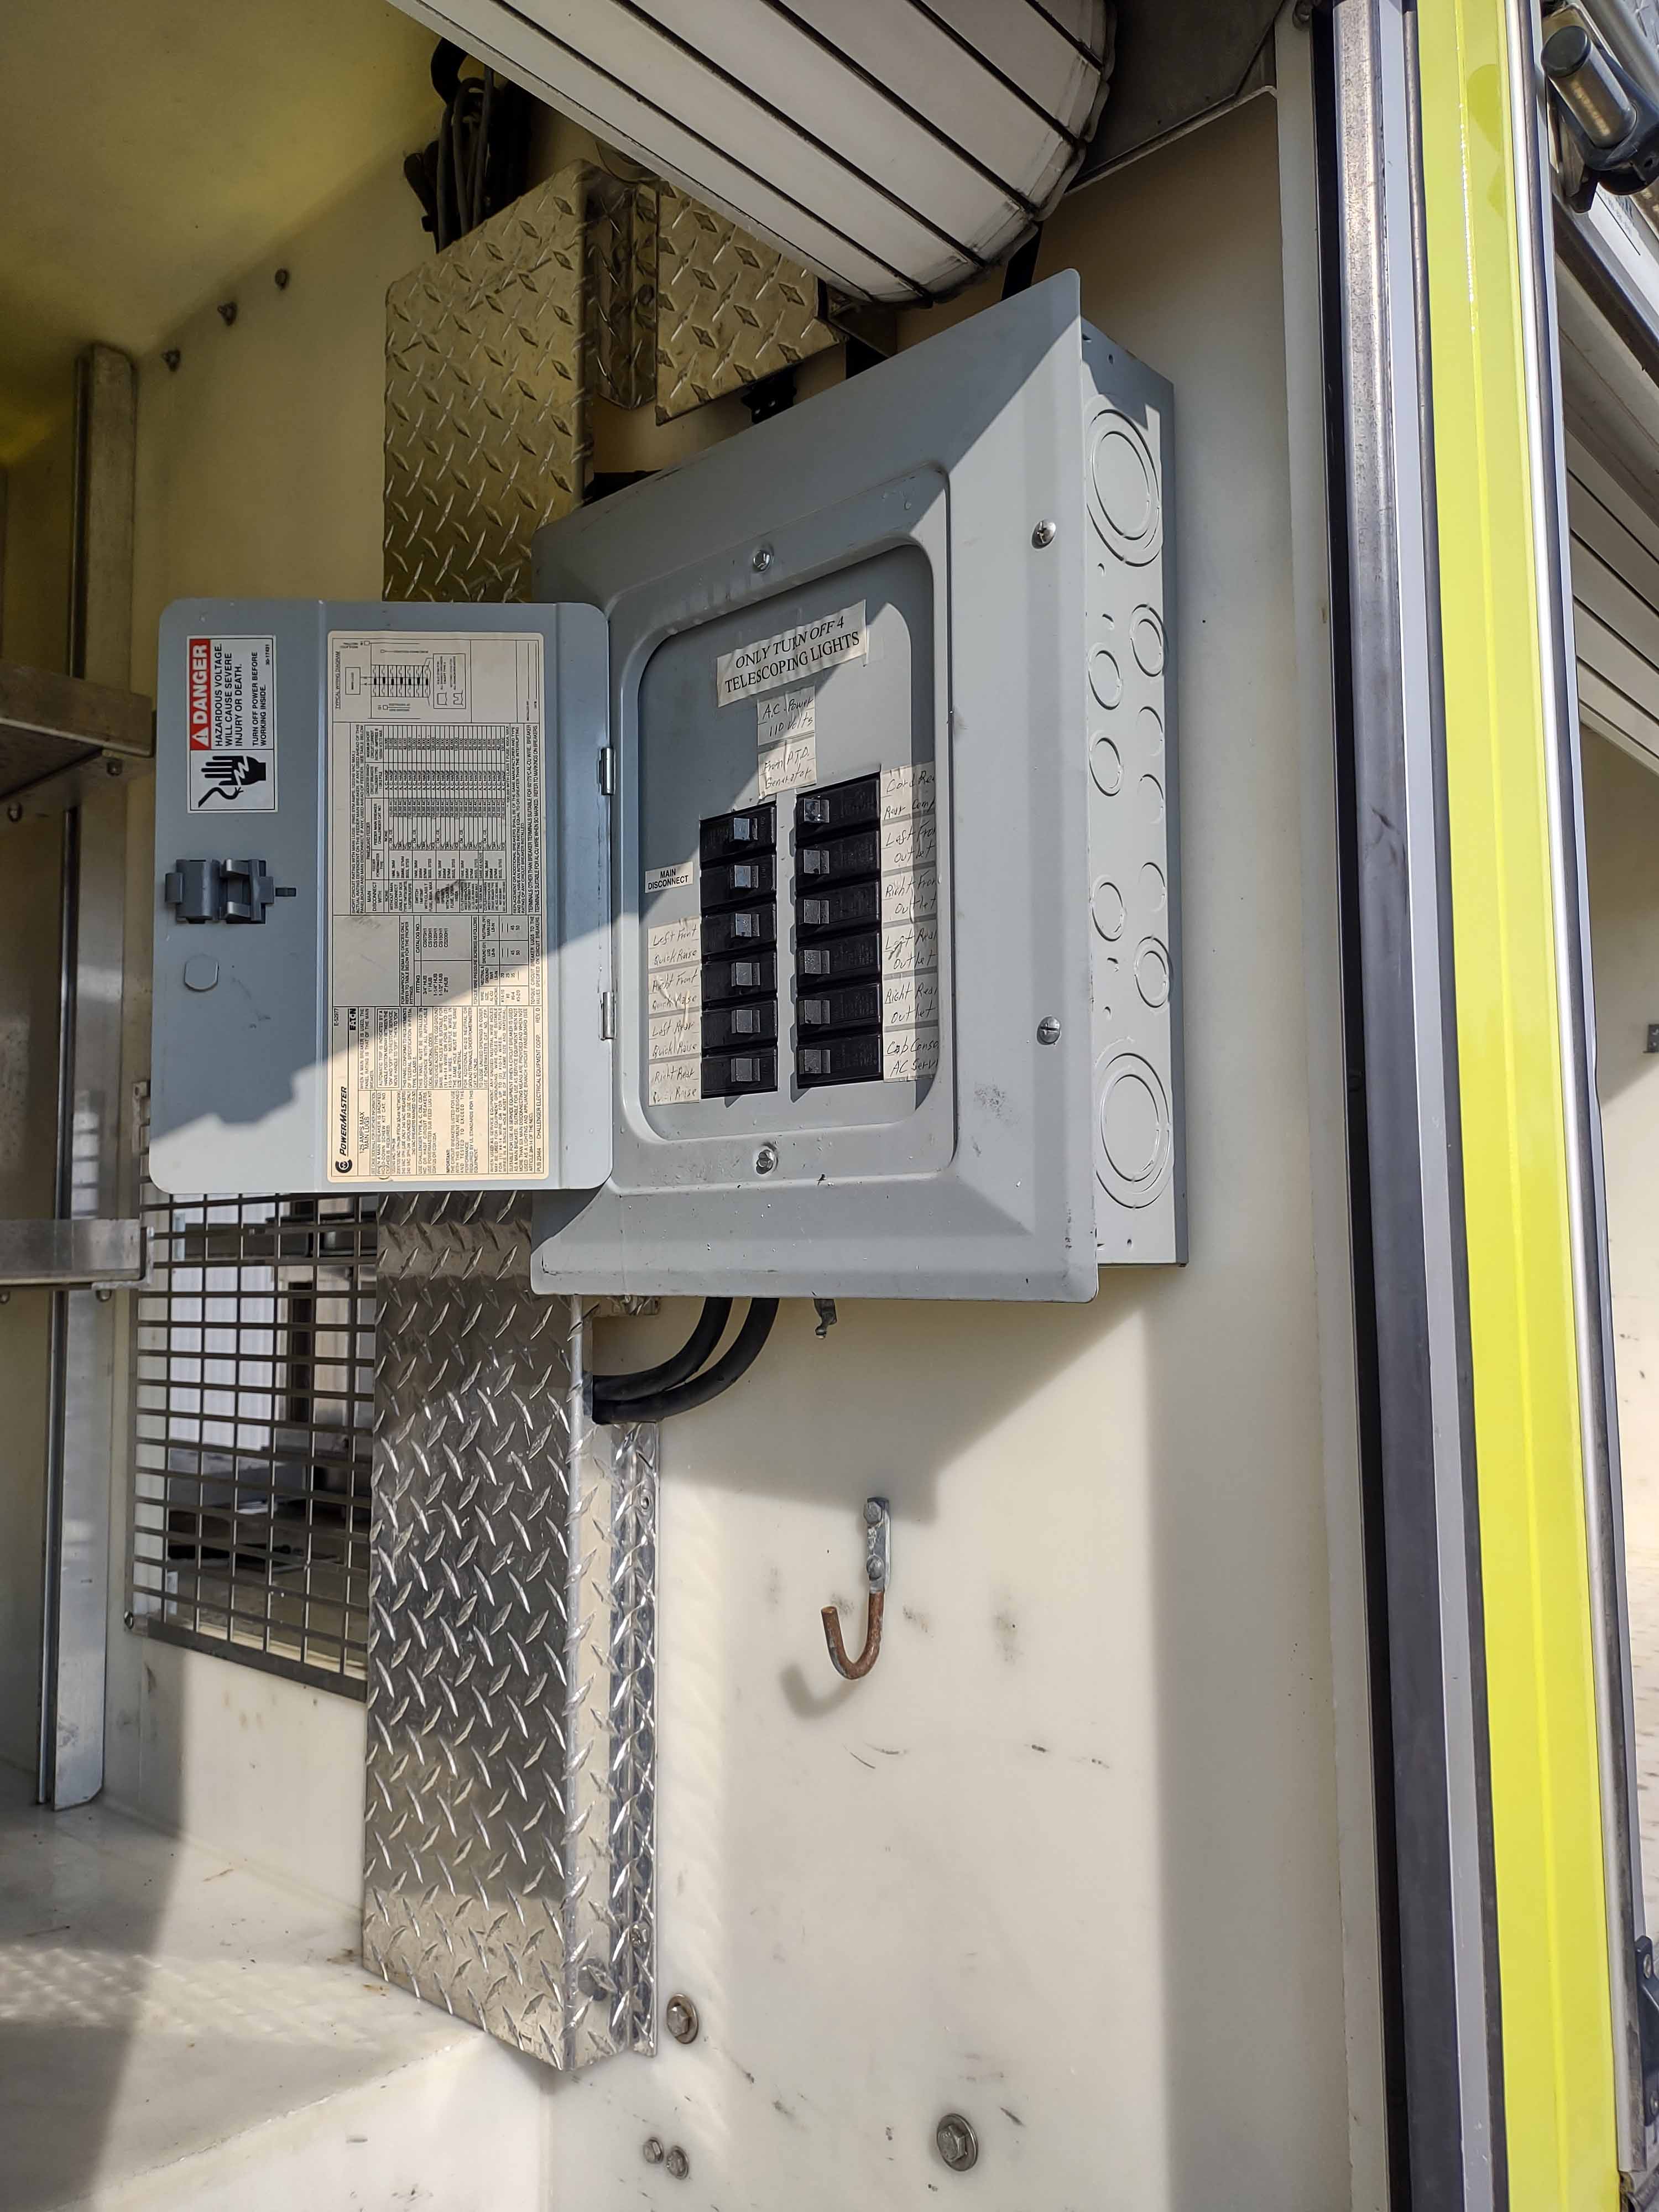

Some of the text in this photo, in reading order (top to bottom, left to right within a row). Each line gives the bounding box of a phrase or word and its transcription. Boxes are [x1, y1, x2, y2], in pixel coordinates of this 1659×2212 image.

[736, 616, 844, 668] ONLY TURN OFF 4
[725, 632, 859, 693] TELESCOPING LIGHTS
[192, 644, 207, 724] DANGER
[234, 699, 242, 712] OR
[787, 698, 814, 712] Power
[215, 690, 223, 747] HAZARDOUS
[769, 712, 813, 737] 110 Volts
[764, 760, 783, 772] From
[765, 764, 812, 789] Generator
[886, 774, 915, 792] Cord
[894, 839, 935, 863] Outlet
[648, 875, 688, 890] DISCONNECT
[660, 868, 676, 879] MAIN
[653, 924, 697, 946] Left Front
[654, 948, 697, 966] Quick Raise
[676, 969, 698, 986] Front
[891, 1000, 936, 1024] Outlet
[653, 1020, 672, 1037] Left
[886, 1035, 909, 1056] Cab
